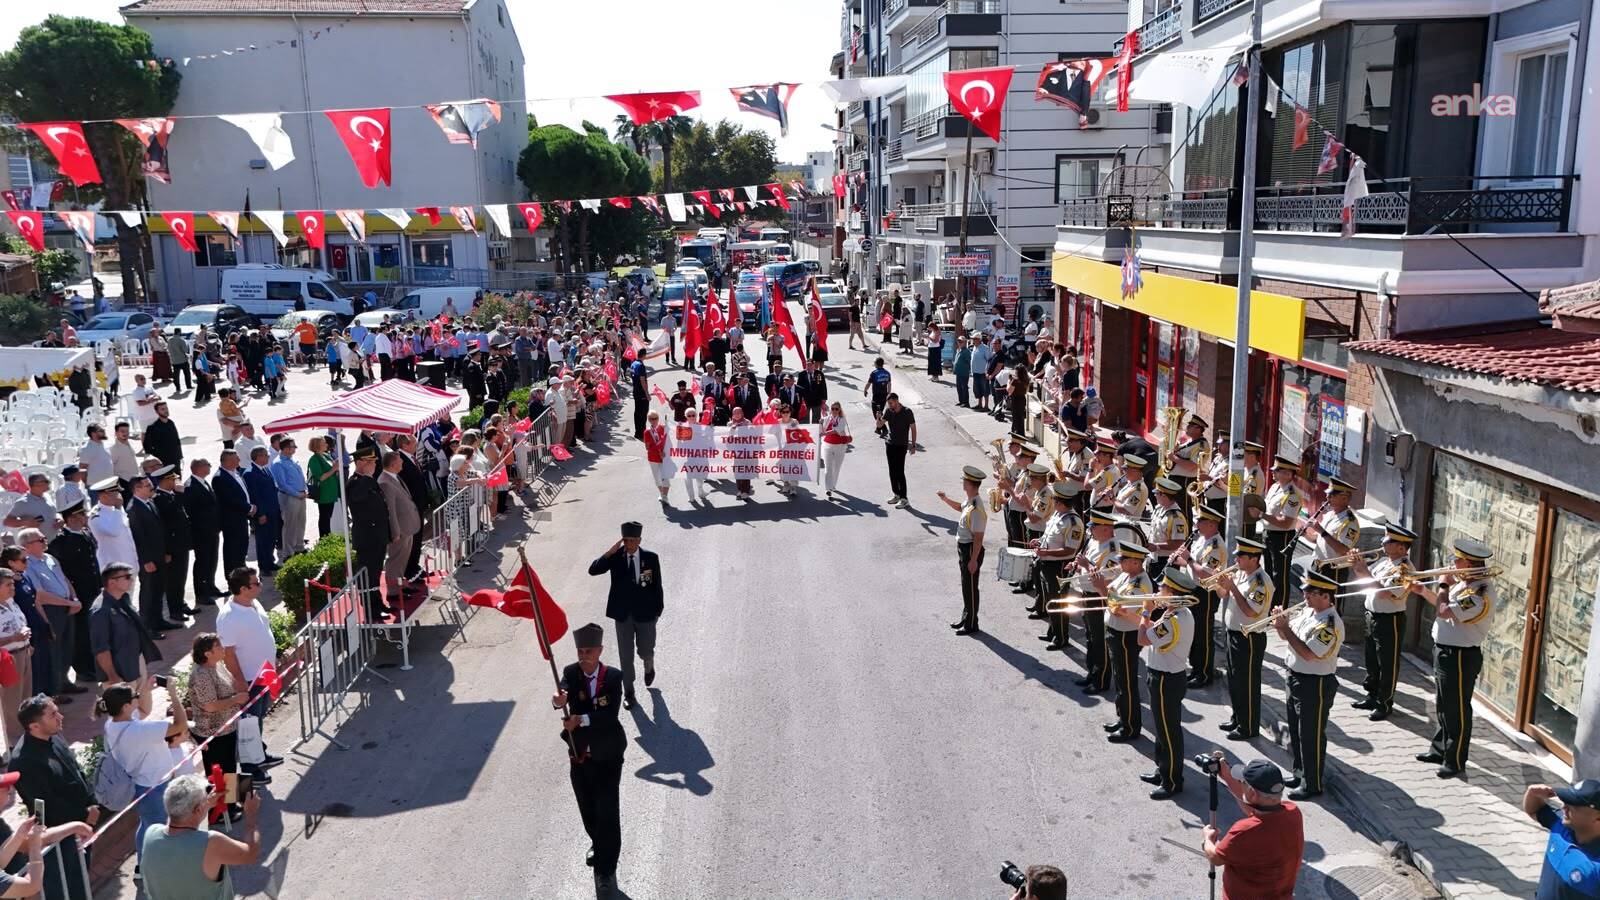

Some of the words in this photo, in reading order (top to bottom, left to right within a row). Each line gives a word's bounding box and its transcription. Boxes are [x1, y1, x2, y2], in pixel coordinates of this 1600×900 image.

[721, 435, 765, 445] TÜRKİYE
[669, 447, 719, 459] MUHARİP
[722, 448, 766, 460] GAZİLER
[769, 449, 815, 461] DERNEĞİ
[680, 465, 727, 474] AYVALIK
[731, 464, 803, 475] TEMSİLCİLİĞİ
